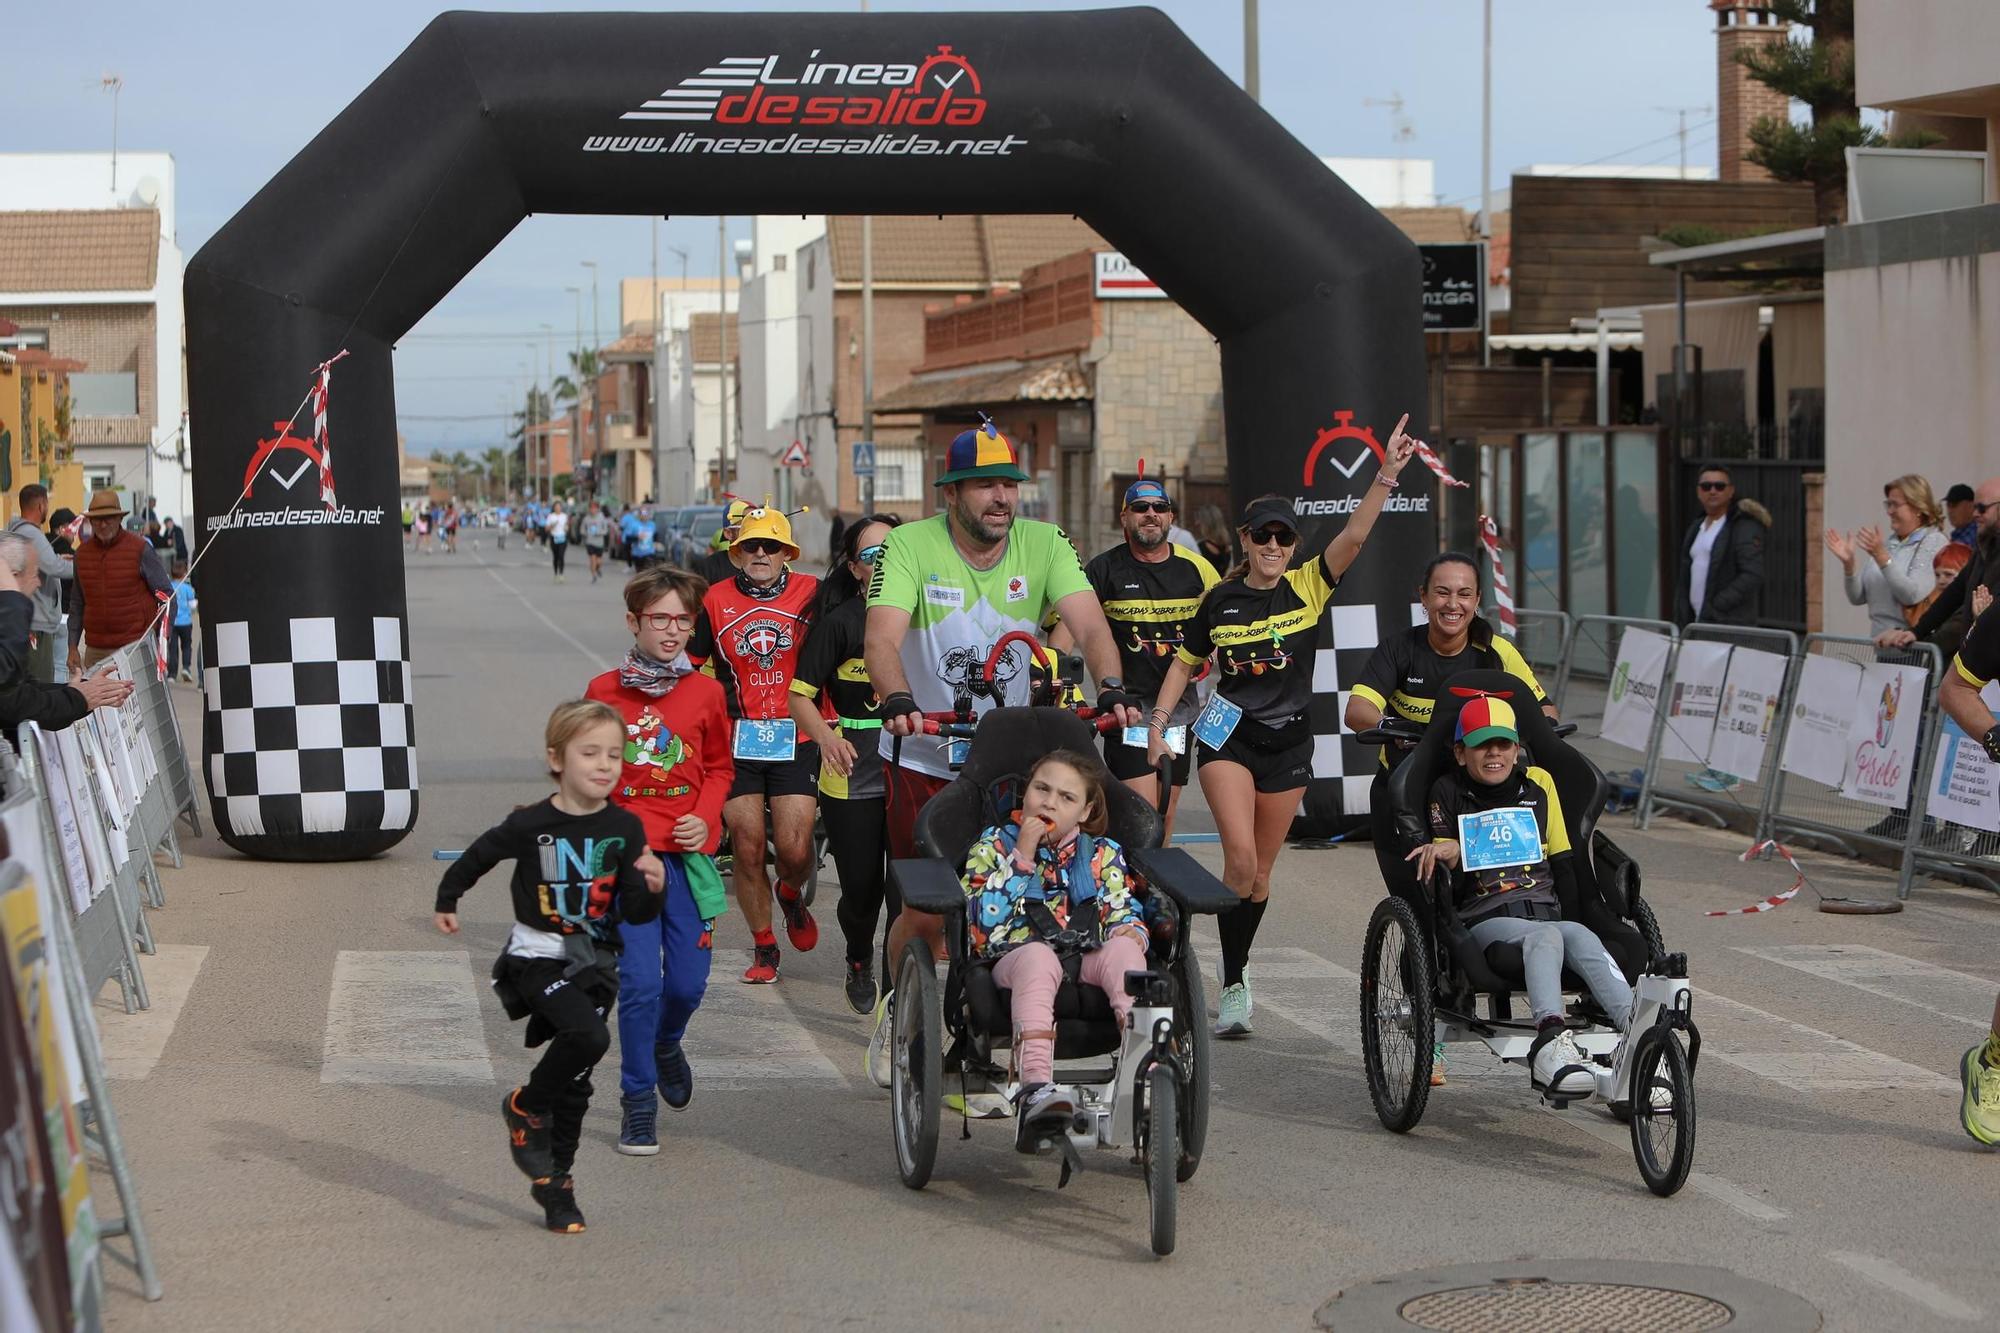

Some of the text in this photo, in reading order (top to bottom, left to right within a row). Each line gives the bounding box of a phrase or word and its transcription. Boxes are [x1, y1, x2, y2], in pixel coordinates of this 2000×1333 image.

[582, 132, 1028, 155] www.lineadesalida.net
[1294, 493, 1430, 516] lineadelida.net
[749, 671, 784, 687] CLUB
[1206, 709, 1224, 727] 80
[757, 729, 775, 743] 58
[661, 784, 690, 797] ARIO
[1489, 825, 1513, 843] 46
[543, 979, 572, 997] KEL
